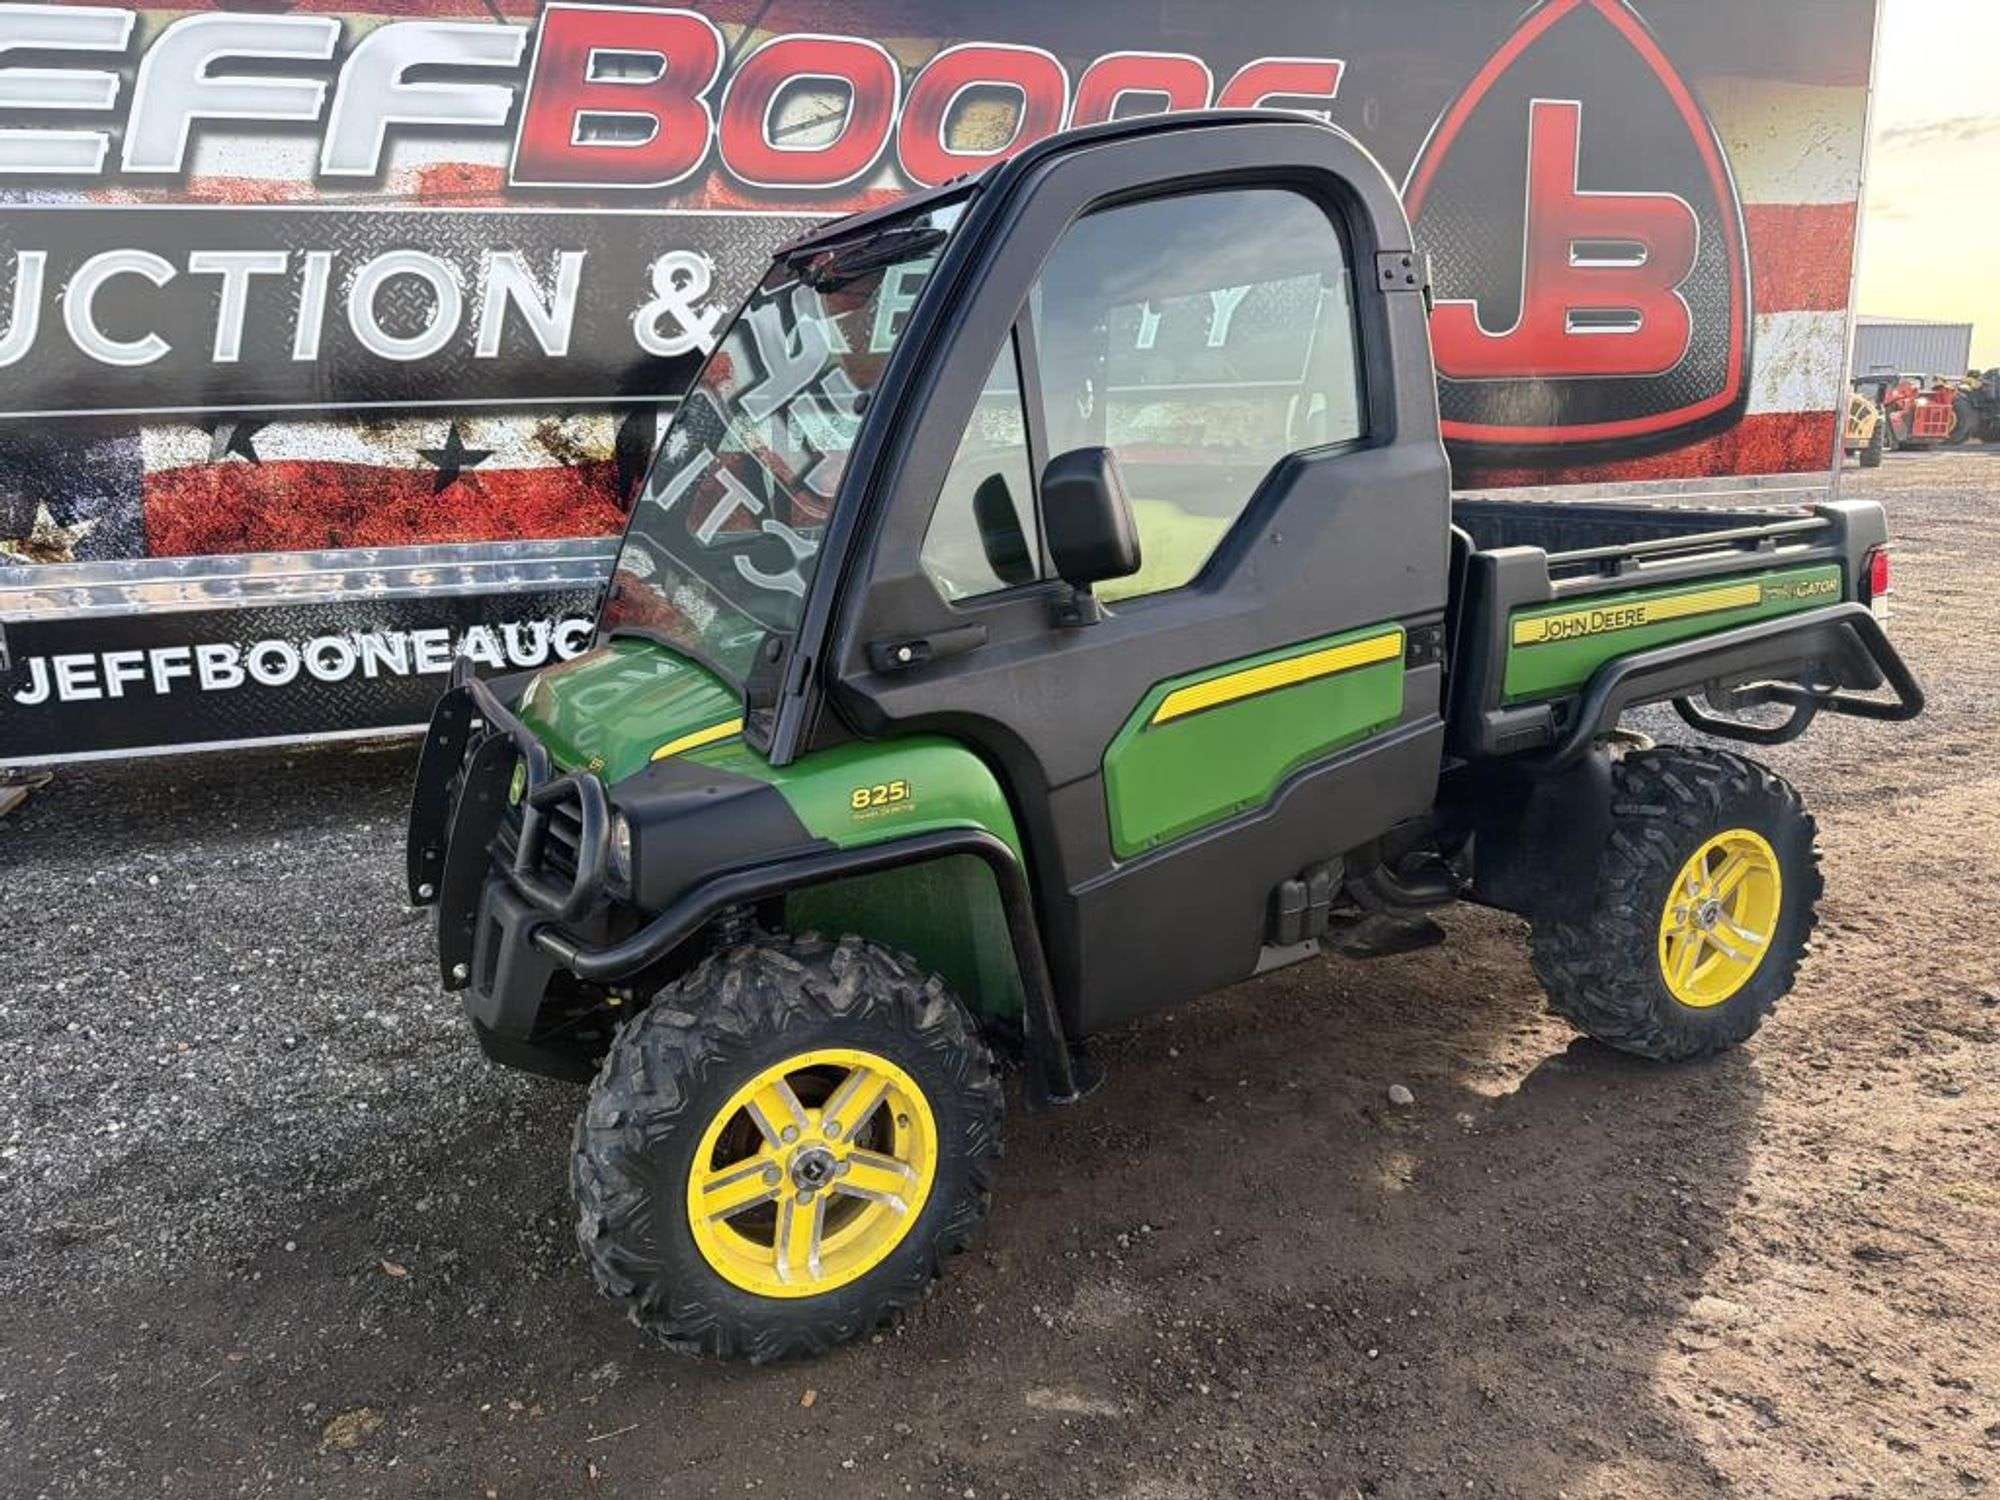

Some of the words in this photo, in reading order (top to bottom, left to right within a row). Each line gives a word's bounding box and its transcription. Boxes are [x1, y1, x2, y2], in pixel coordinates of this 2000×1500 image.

[632, 248, 724, 357] &
[1538, 618, 1587, 639] JOHN
[1591, 607, 1646, 630] DEERE
